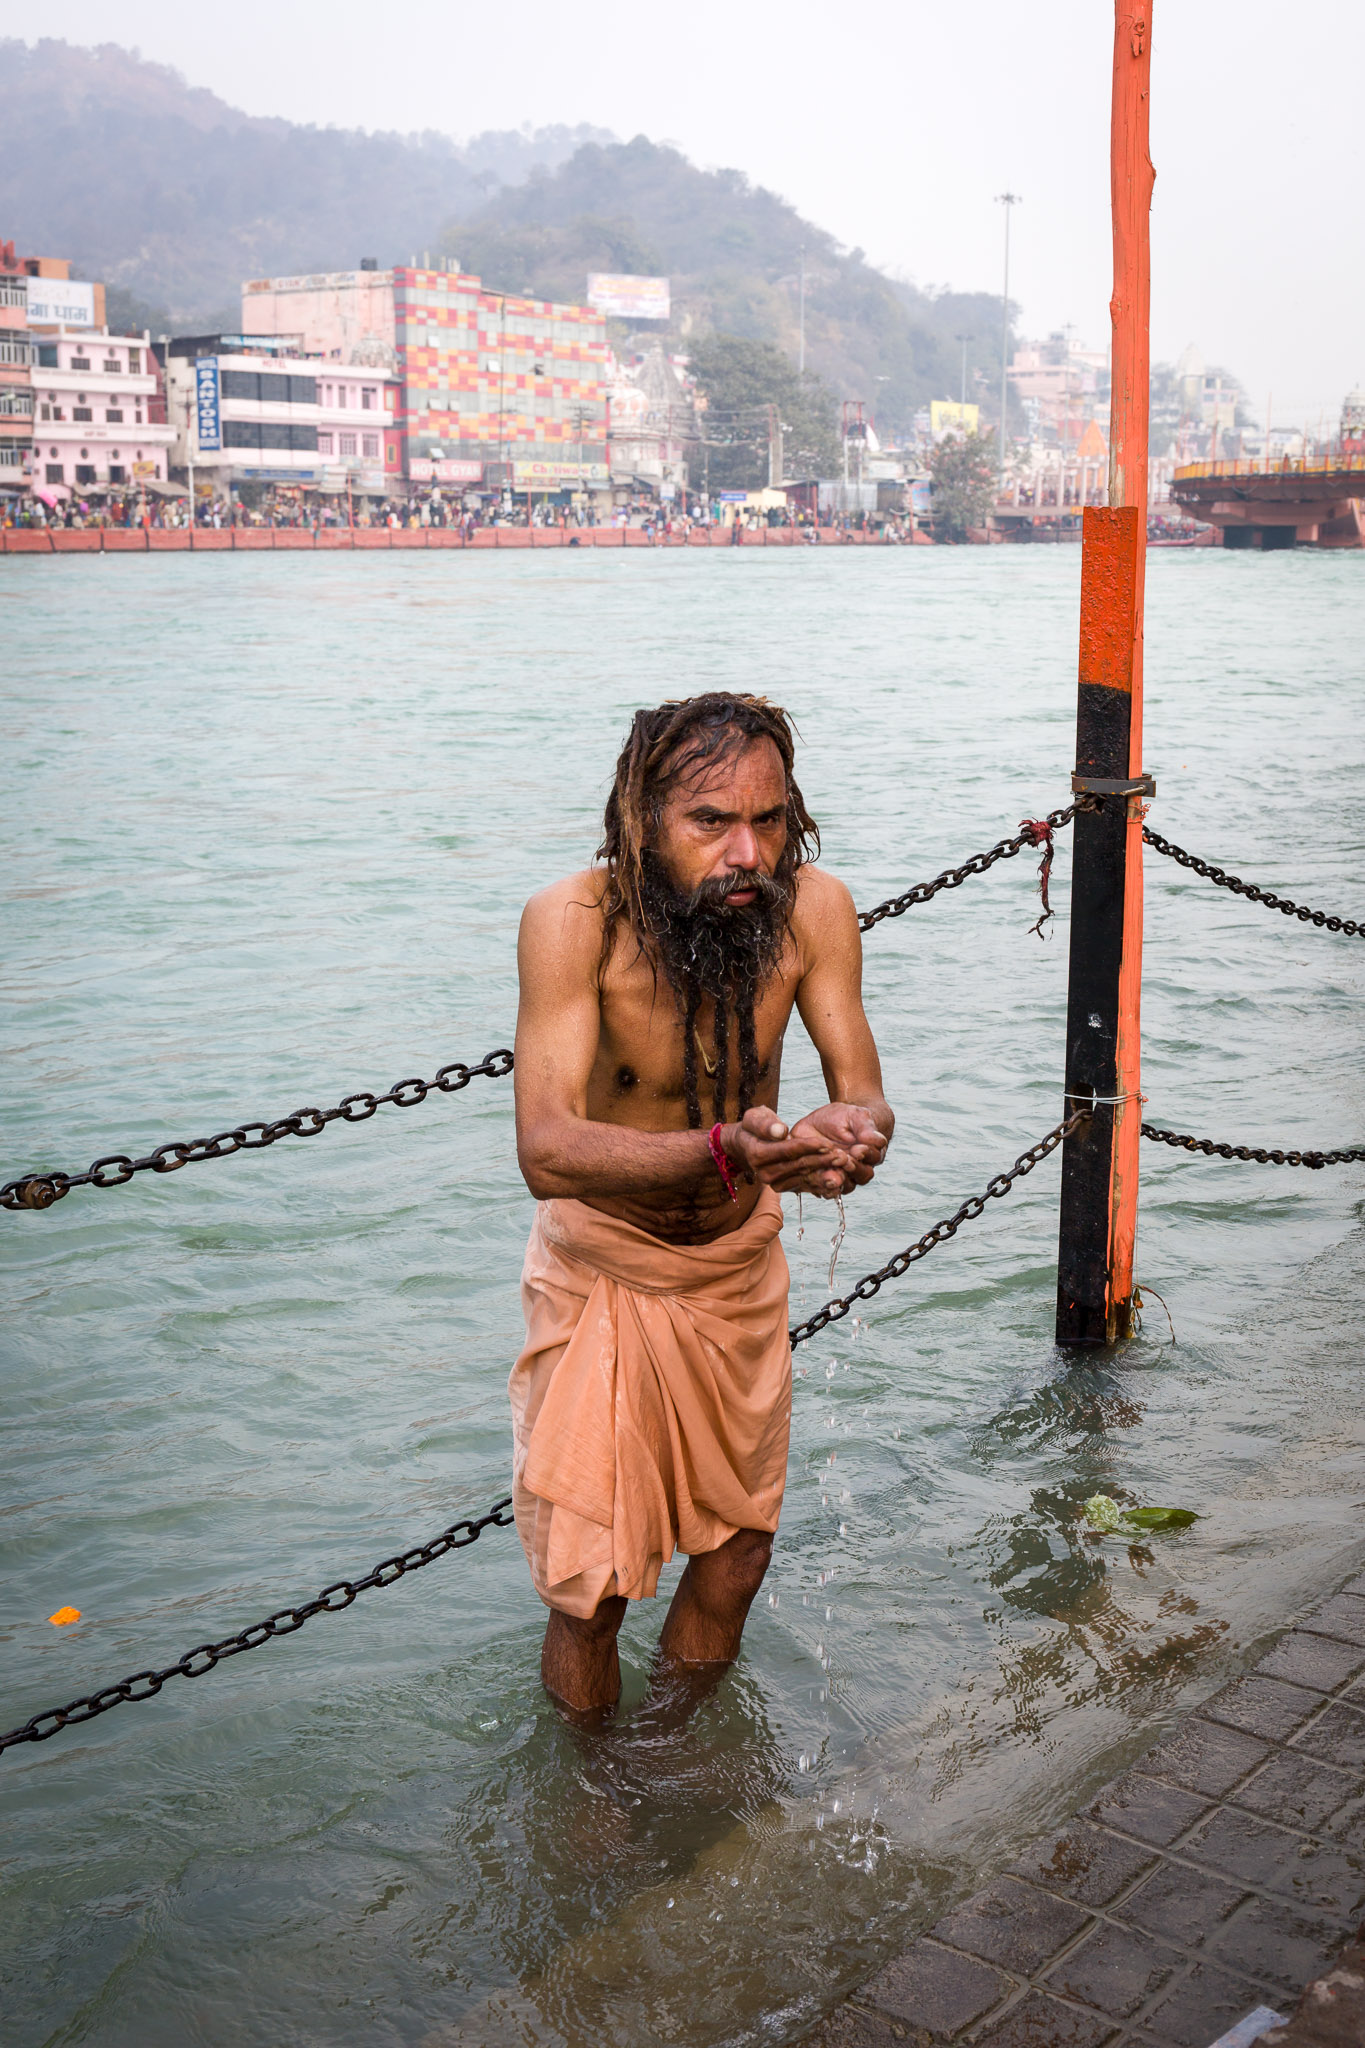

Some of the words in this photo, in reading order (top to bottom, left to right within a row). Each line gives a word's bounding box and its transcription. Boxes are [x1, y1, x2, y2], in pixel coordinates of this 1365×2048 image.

[262, 360, 286, 369] HOTEL
[199, 370, 217, 437] SANTOSH
[410, 463, 448, 476] HOTEL
[450, 464, 481, 477] GYAN
